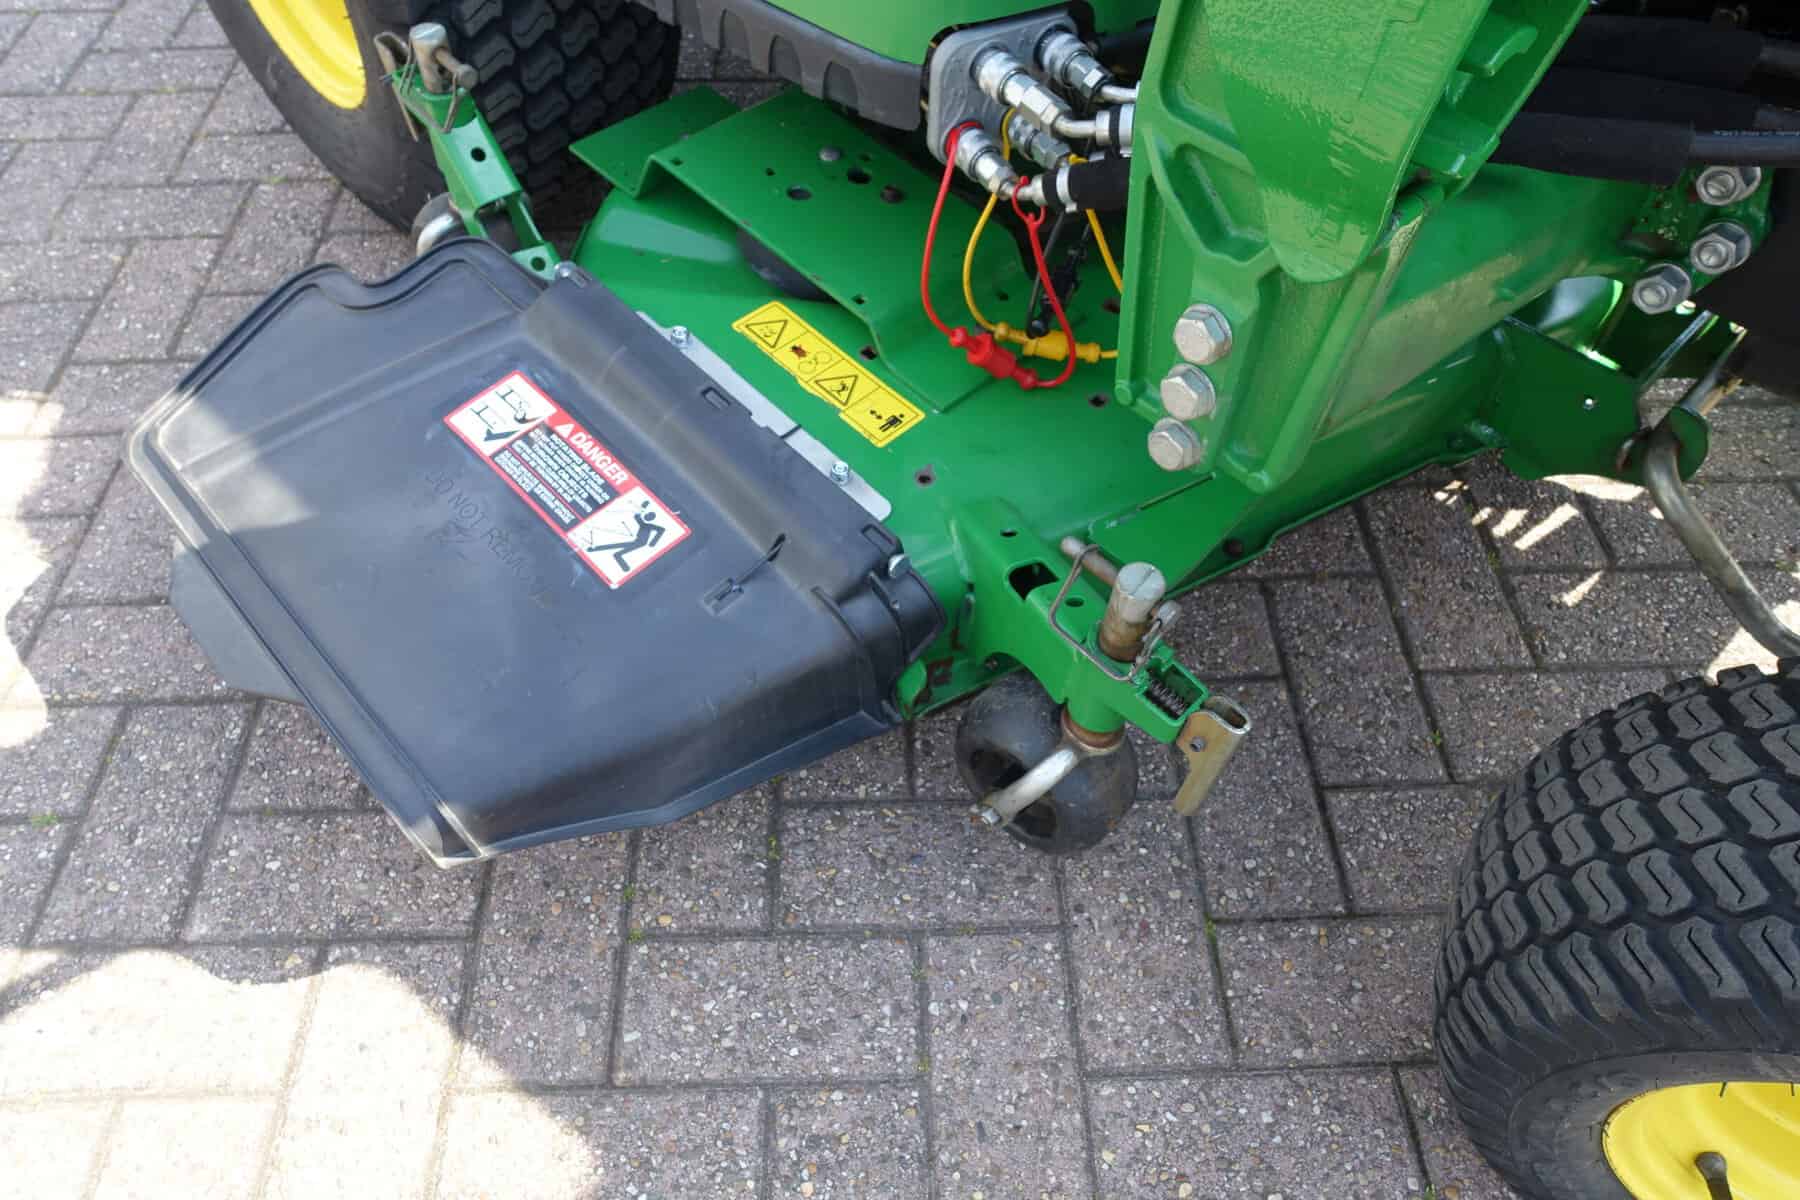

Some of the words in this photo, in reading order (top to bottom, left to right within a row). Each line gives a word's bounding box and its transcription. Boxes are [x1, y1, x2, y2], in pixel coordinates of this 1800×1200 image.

[531, 444, 560, 471] THROWN
[557, 468, 589, 499] OBJECTS
[550, 433, 583, 465] ROTATING
[581, 463, 605, 485] BLADE
[570, 433, 629, 485] DANGER
